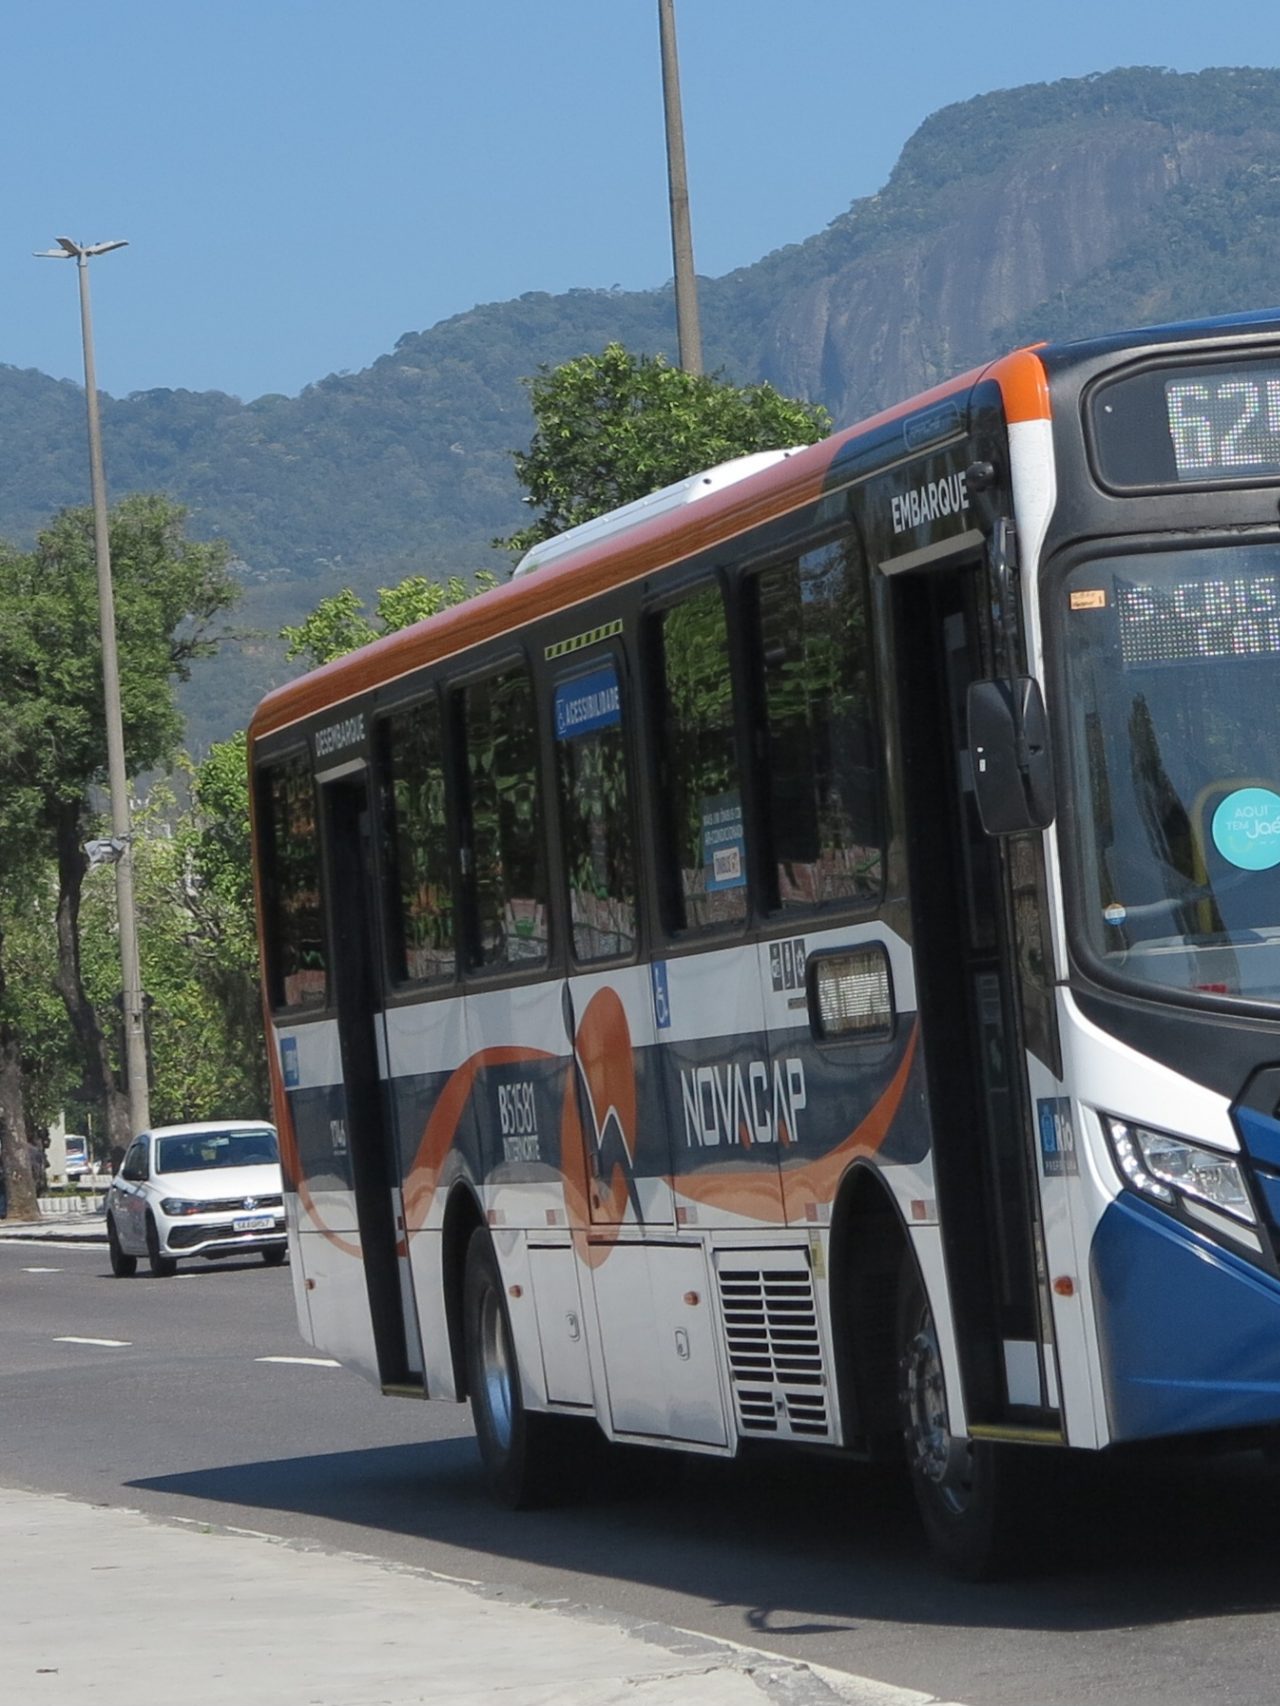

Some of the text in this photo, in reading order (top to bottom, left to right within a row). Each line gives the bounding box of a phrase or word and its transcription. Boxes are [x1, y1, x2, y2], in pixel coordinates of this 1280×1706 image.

[891, 471, 970, 535] EMBARQUE
[315, 713, 366, 757] DESEMBARQUE
[1234, 805, 1269, 818] AQUI
[498, 1082, 538, 1134] B51581
[681, 1058, 807, 1148] NOVACAP
